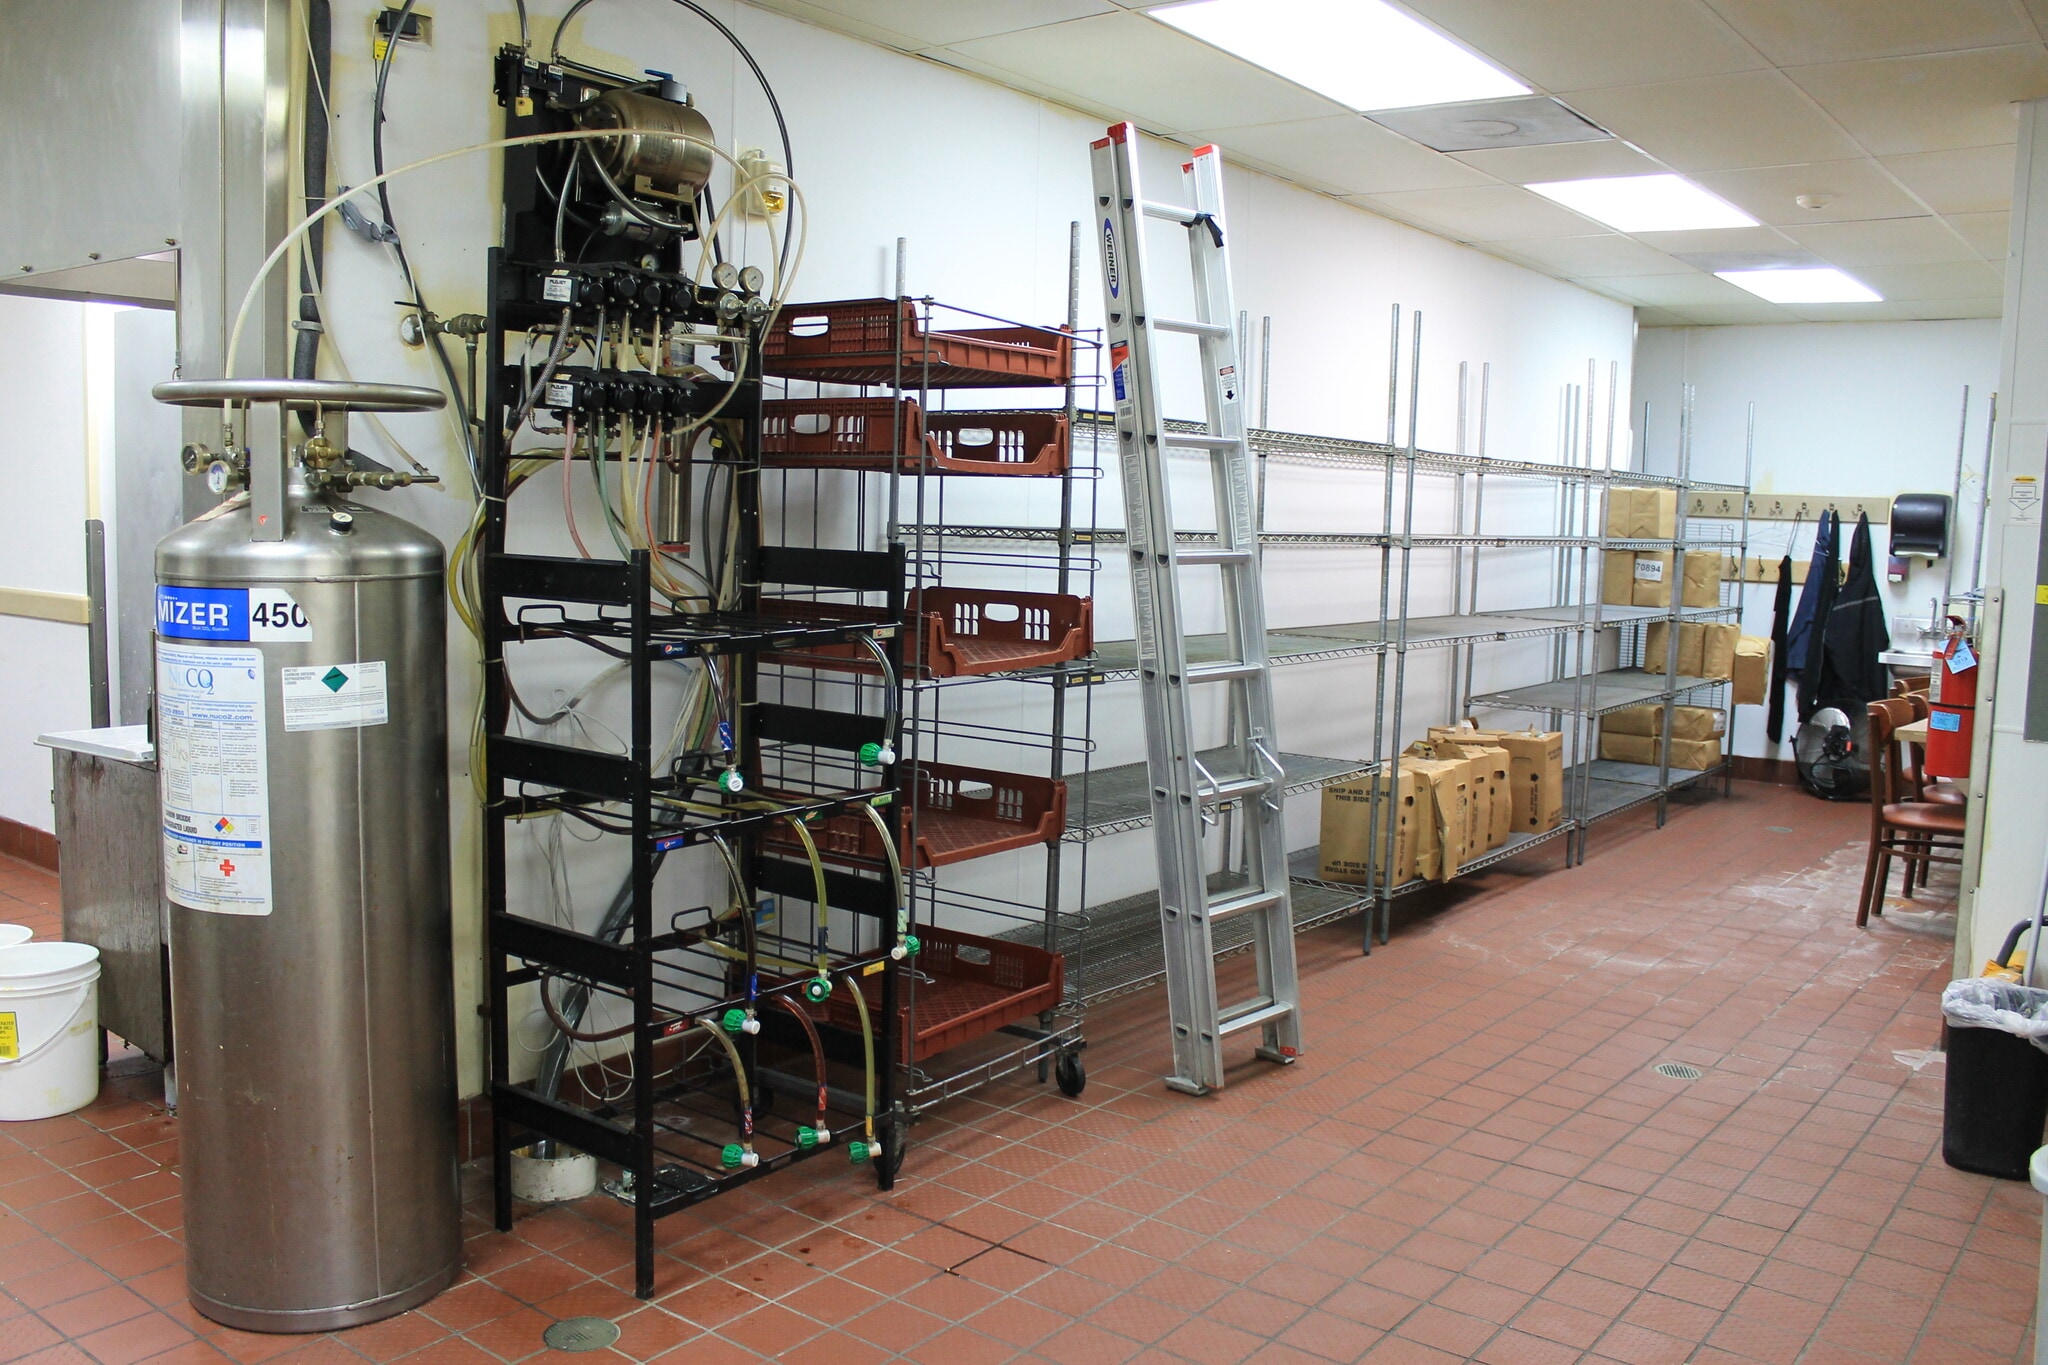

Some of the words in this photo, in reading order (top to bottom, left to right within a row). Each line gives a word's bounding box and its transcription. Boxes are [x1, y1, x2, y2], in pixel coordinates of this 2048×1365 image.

[1105, 233, 1117, 283] WERNER
[1636, 562, 1661, 573] 70894
[158, 600, 228, 626] MIZER
[252, 602, 308, 629] 450
[192, 712, 253, 721] www.nuco2.com
[1335, 794, 1351, 802] THIS
[1366, 790, 1391, 798] SRE
[1324, 865, 1348, 874] STORE
